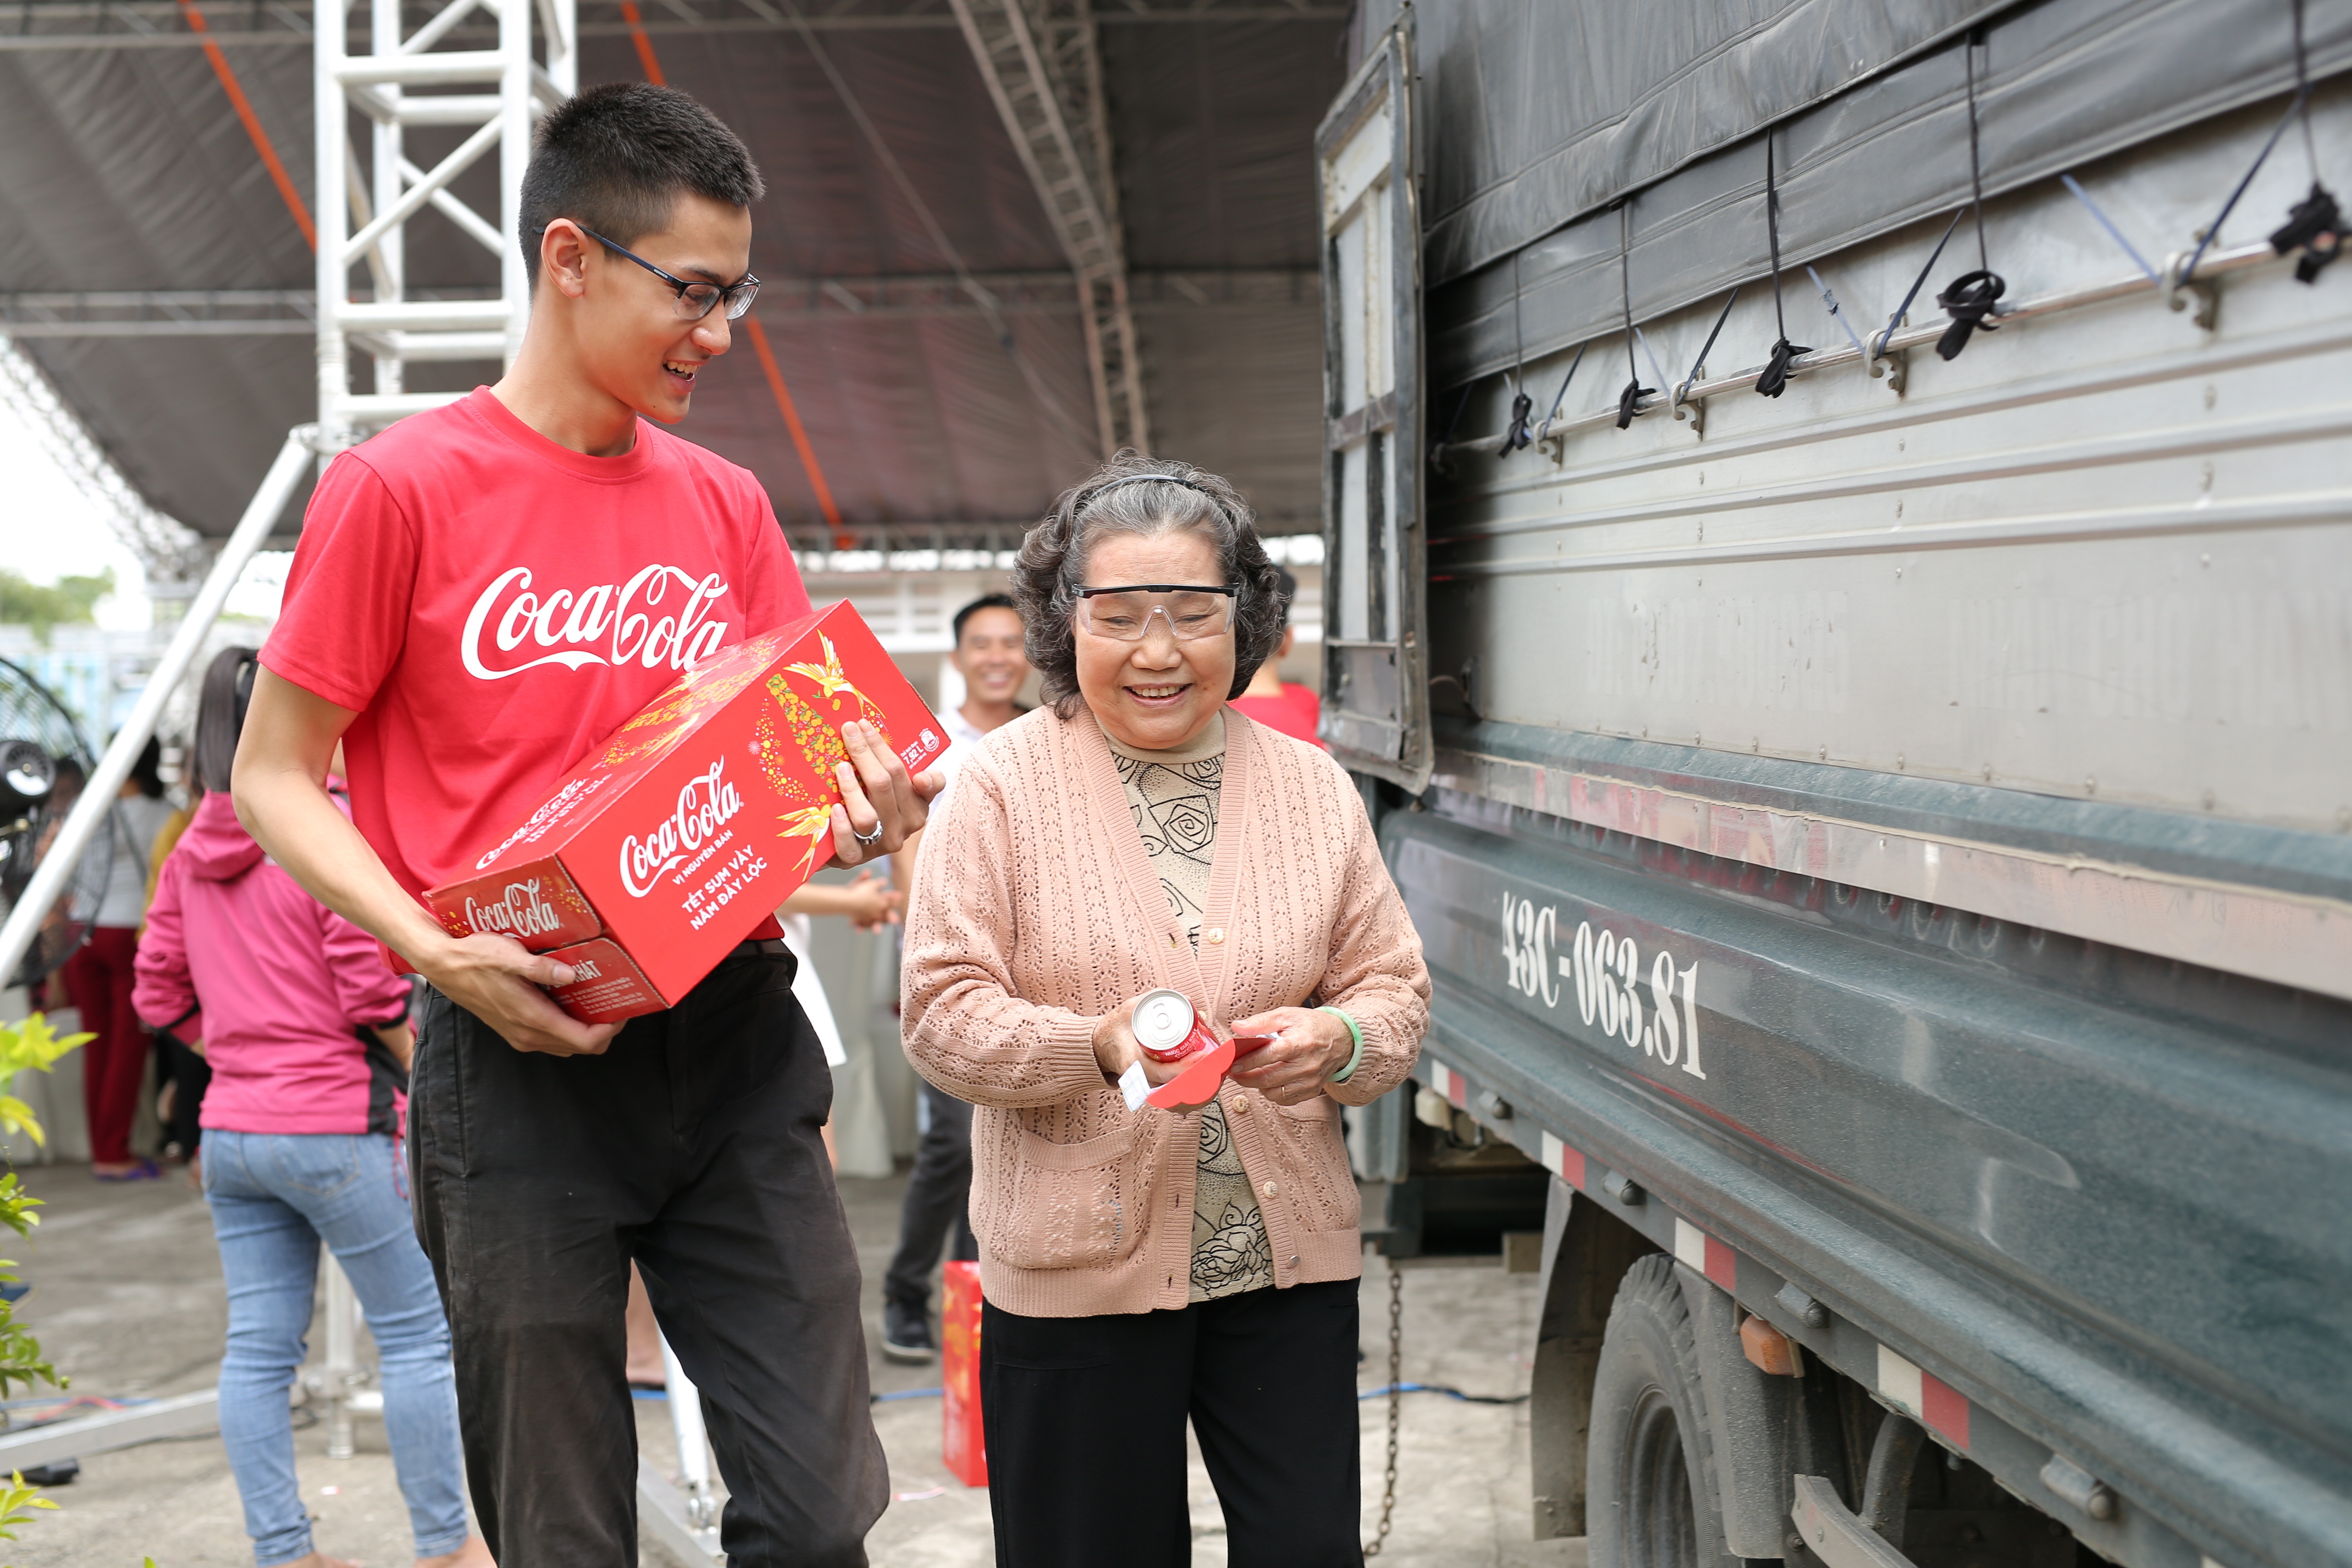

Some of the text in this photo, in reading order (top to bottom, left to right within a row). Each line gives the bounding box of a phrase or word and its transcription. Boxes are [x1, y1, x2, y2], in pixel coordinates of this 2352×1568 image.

[461, 564, 728, 679] Coca-Cola
[903, 749, 919, 764] 7,92
[620, 754, 740, 898] Coca-Cola
[672, 829, 733, 885] VỊ NGUYÊN BẢN
[465, 877, 560, 939] Coca-Cola
[682, 844, 754, 913] TẾT SUM VẦY
[690, 857, 767, 930] NĂM ĐẦY LỘC
